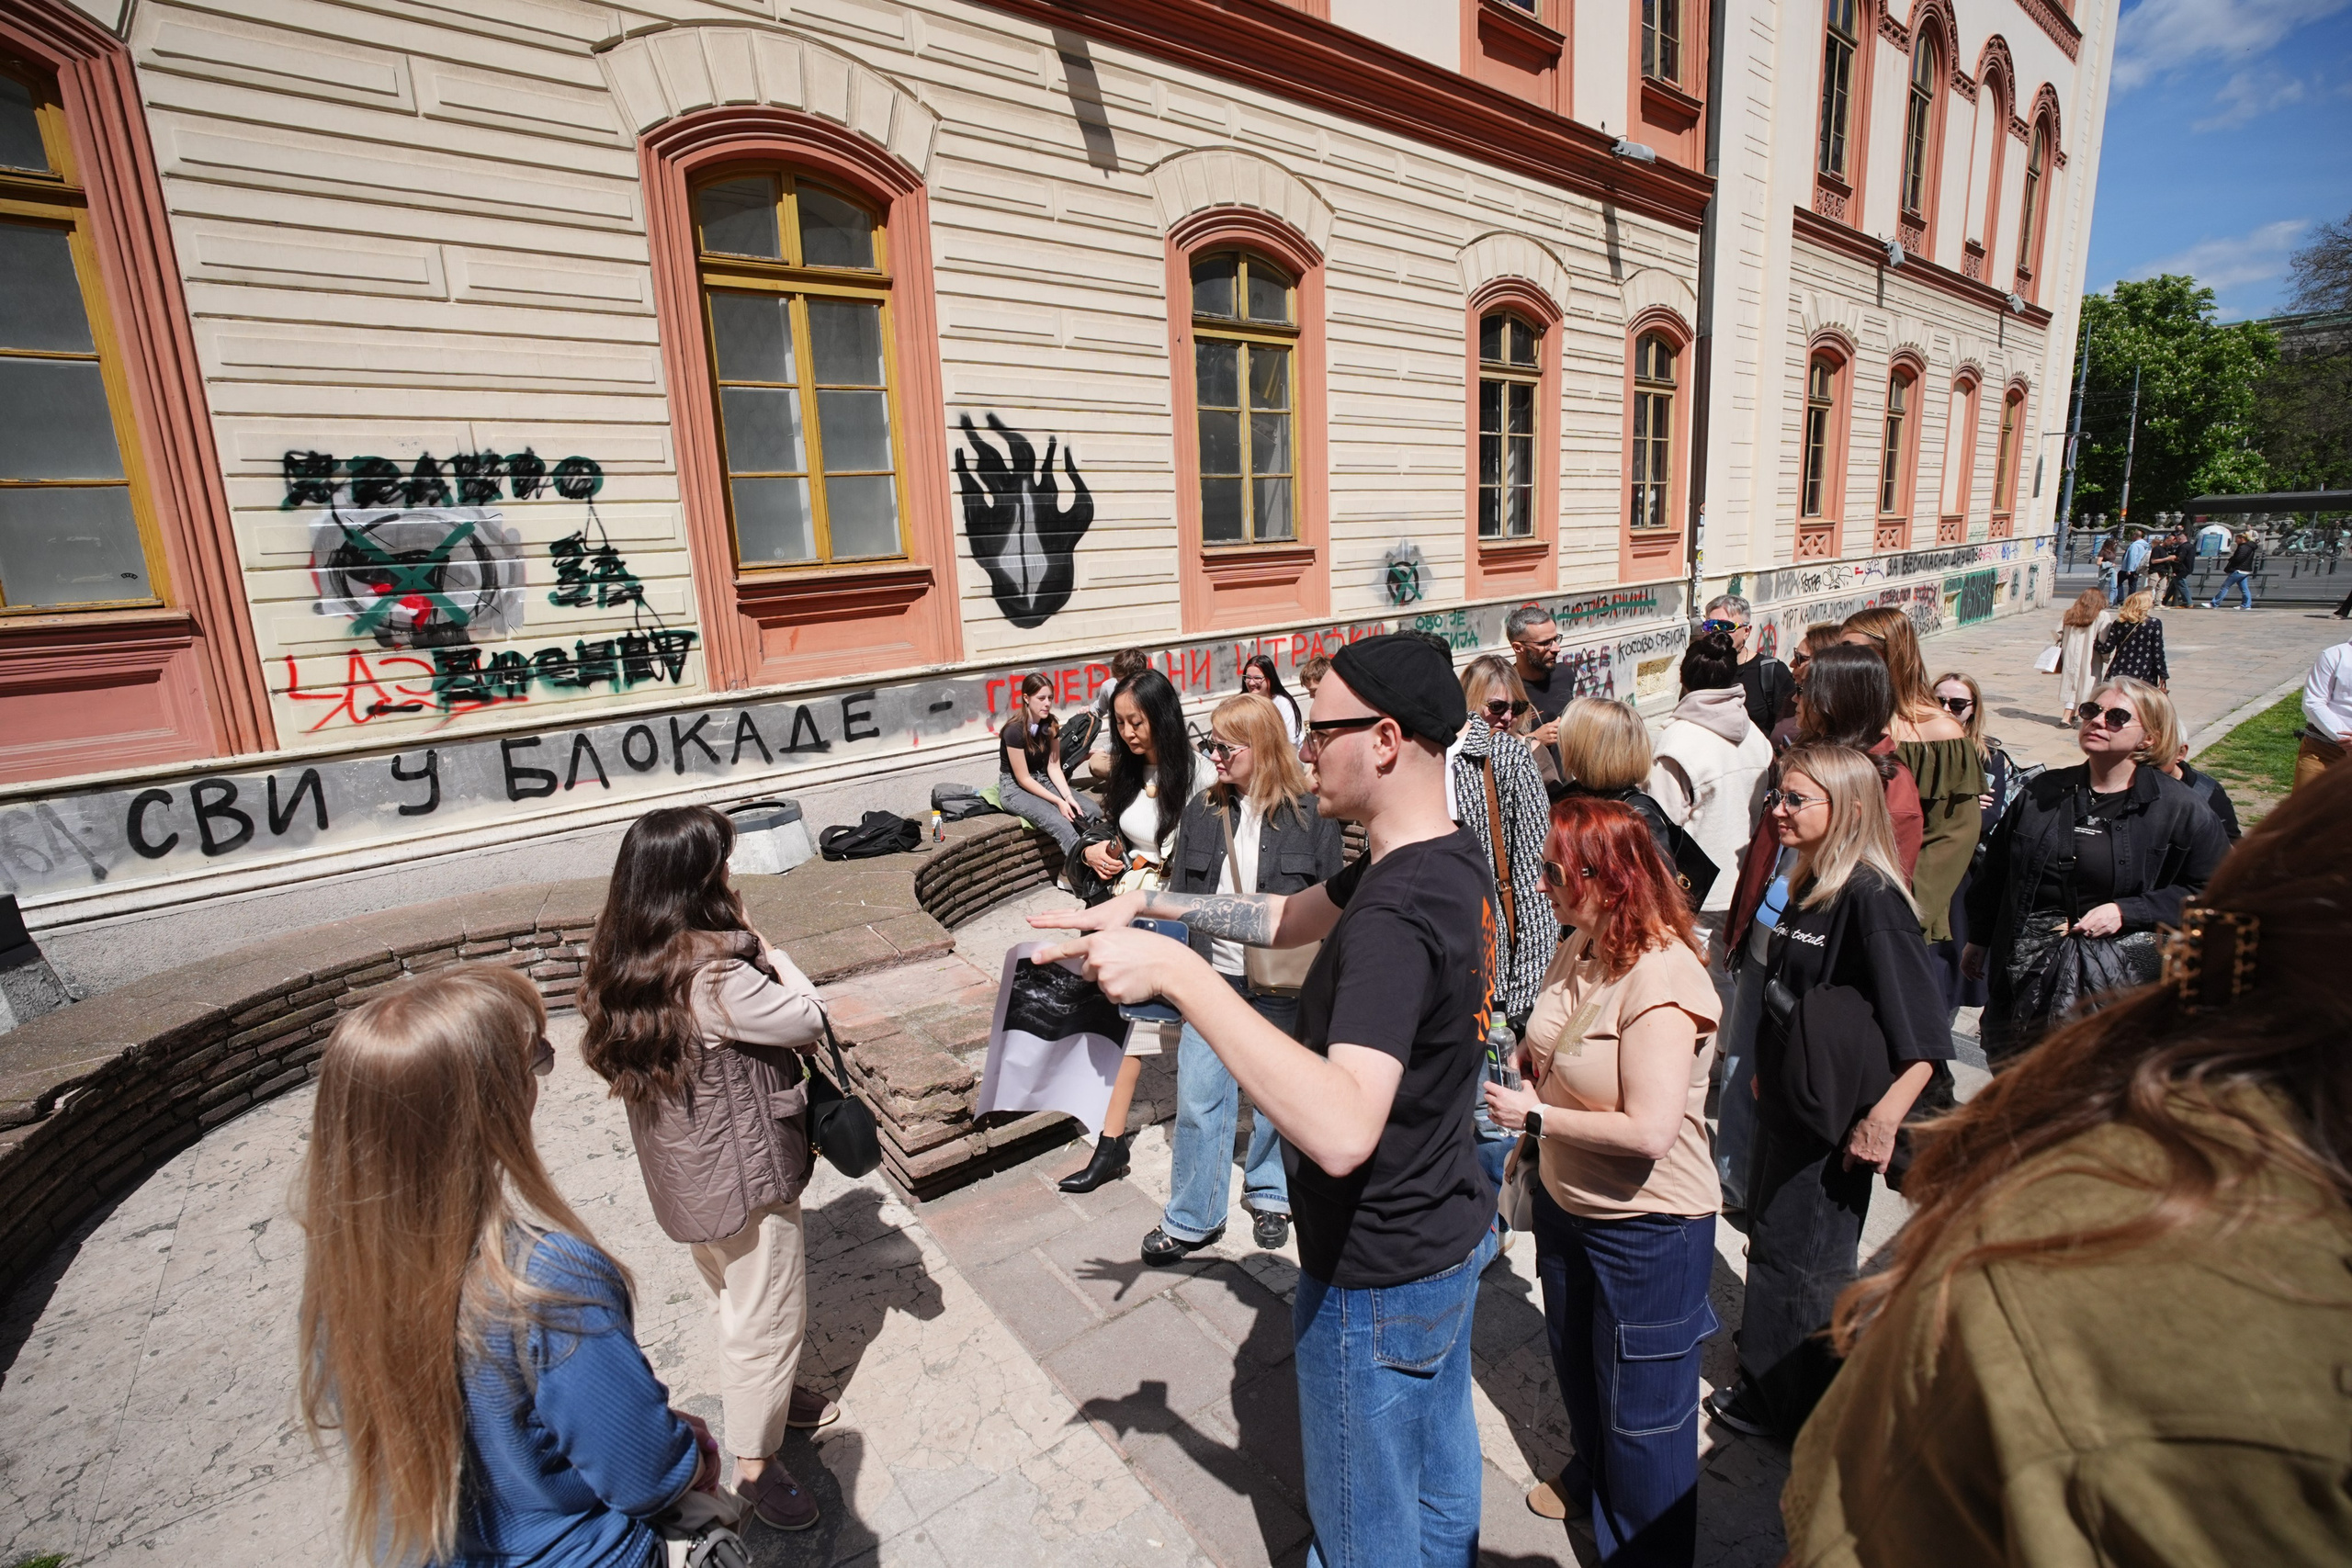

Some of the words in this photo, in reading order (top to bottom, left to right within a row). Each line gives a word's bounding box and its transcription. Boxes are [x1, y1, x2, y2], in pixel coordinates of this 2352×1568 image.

[1887, 558, 1898, 578] ЗА
[1415, 615, 1443, 631] ОВО
[1448, 610, 1466, 628] ЈЕ
[1618, 636, 1655, 664] КОСОВО
[127, 768, 329, 858] СВИ
[390, 749, 438, 816] У
[501, 691, 880, 802] БЛОКАДЕ
[986, 649, 1210, 714] ГЕНЕРНИ
[1792, 929, 1826, 947] total.
